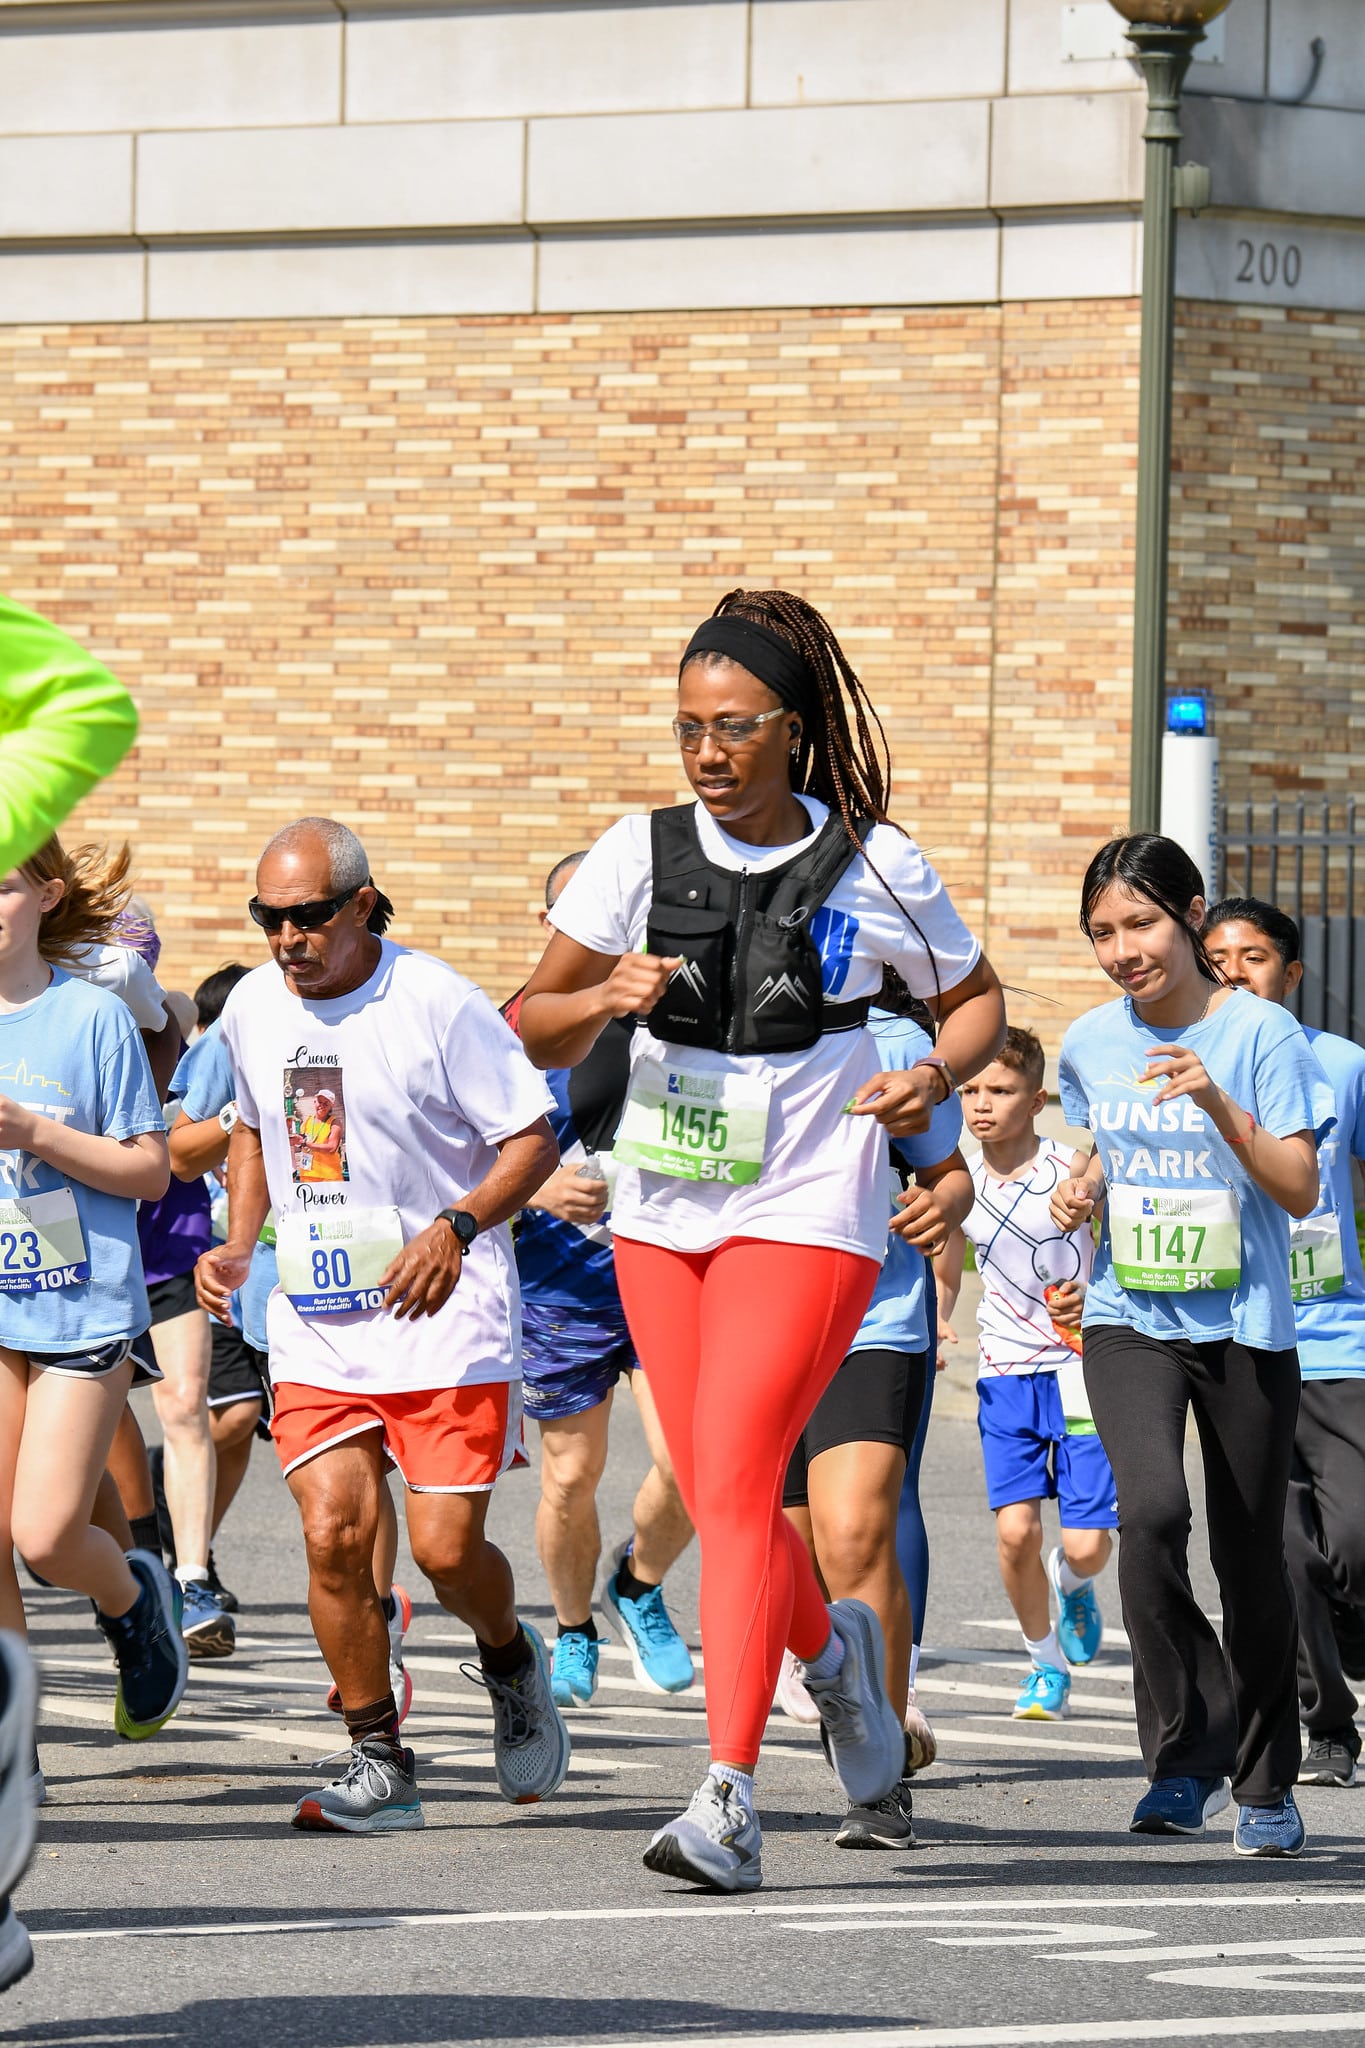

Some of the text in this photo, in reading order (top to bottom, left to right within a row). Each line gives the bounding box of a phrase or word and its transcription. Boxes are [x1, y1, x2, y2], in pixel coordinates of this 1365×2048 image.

[1237, 239, 1302, 289] 200
[287, 1045, 340, 1068] Cuevas
[659, 1101, 728, 1152] 1455
[1089, 1102, 1218, 1133] SUNSE
[700, 1159, 736, 1182] 5K
[1108, 1148, 1214, 1179] PARK
[296, 1183, 347, 1212] Power
[0, 1231, 42, 1269] 23
[1132, 1224, 1206, 1263] 1147
[34, 1266, 80, 1290] 10K
[311, 1248, 352, 1289] 80
[1184, 1271, 1216, 1289] 5K
[313, 1298, 326, 1306] Run
[1301, 1280, 1325, 1298] 5K
